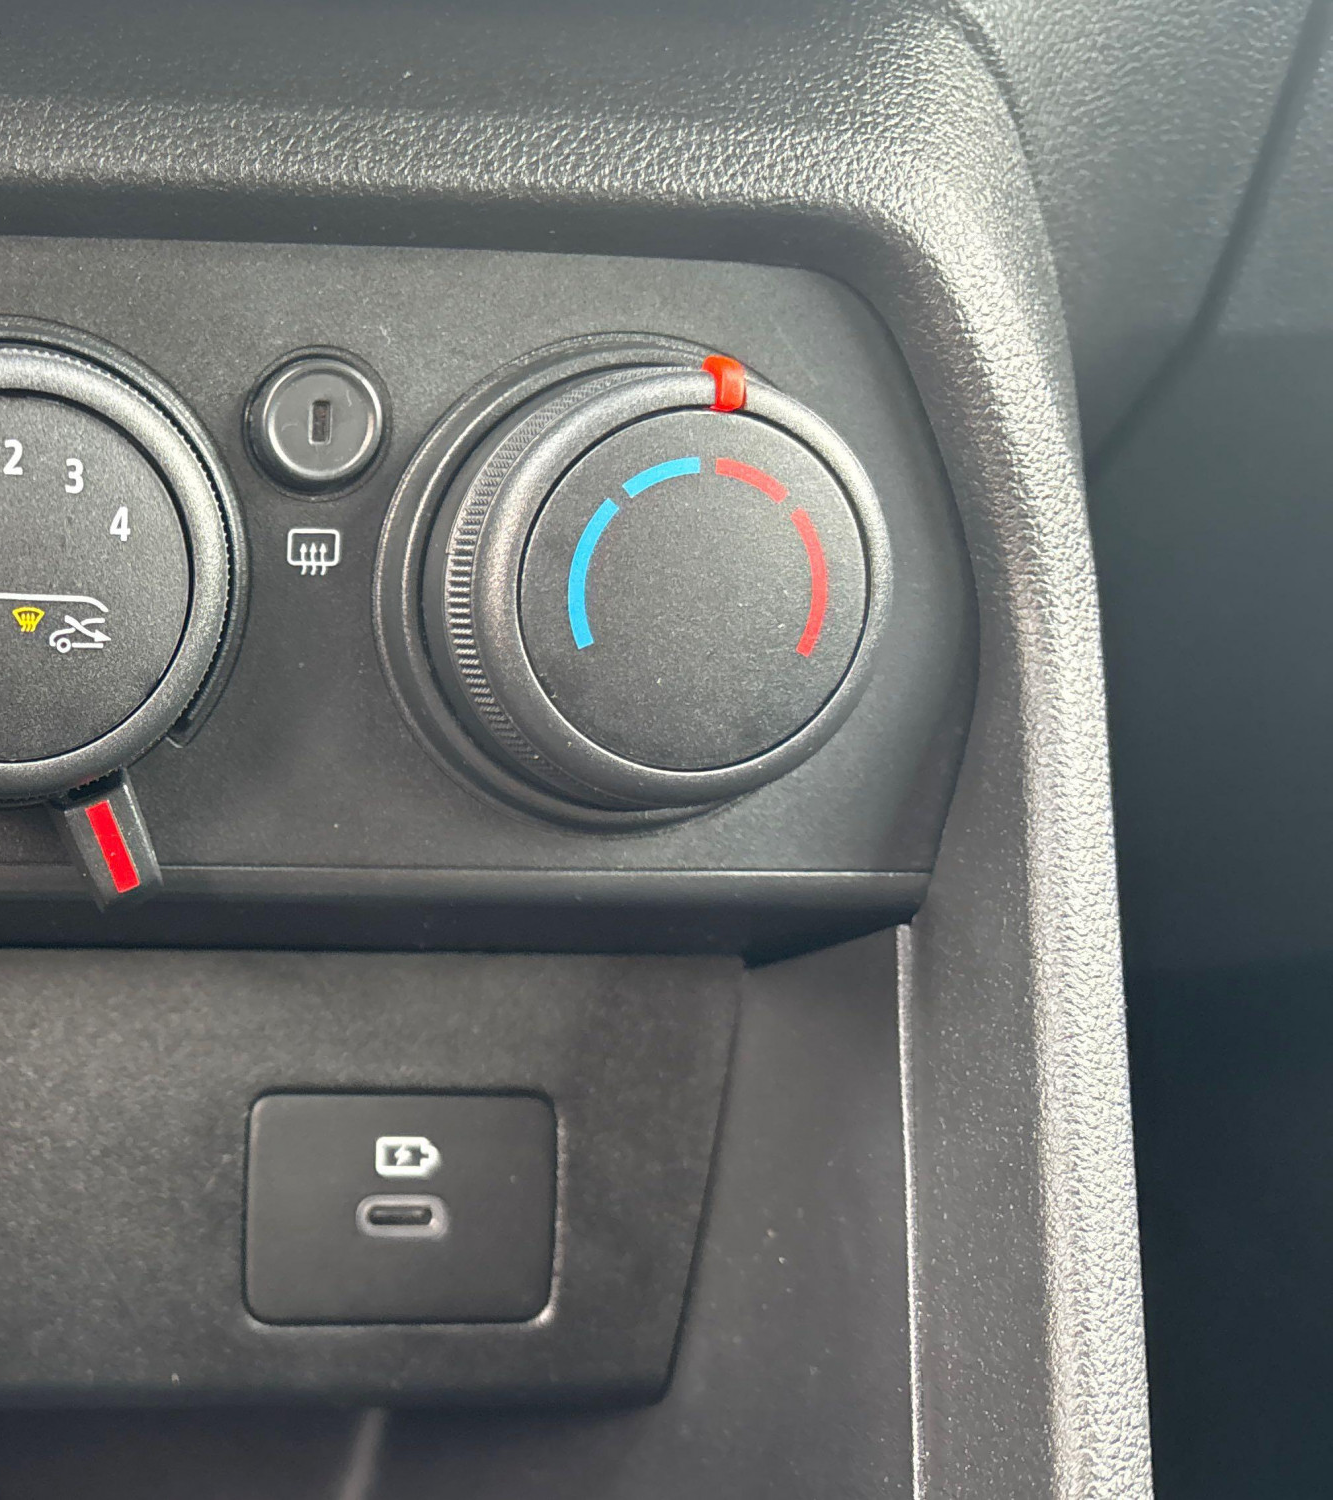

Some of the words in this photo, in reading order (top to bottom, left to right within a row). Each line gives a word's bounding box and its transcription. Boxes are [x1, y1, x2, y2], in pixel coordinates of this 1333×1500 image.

[2, 438, 24, 476] 2
[64, 457, 84, 494] 3
[109, 505, 131, 542] 4
